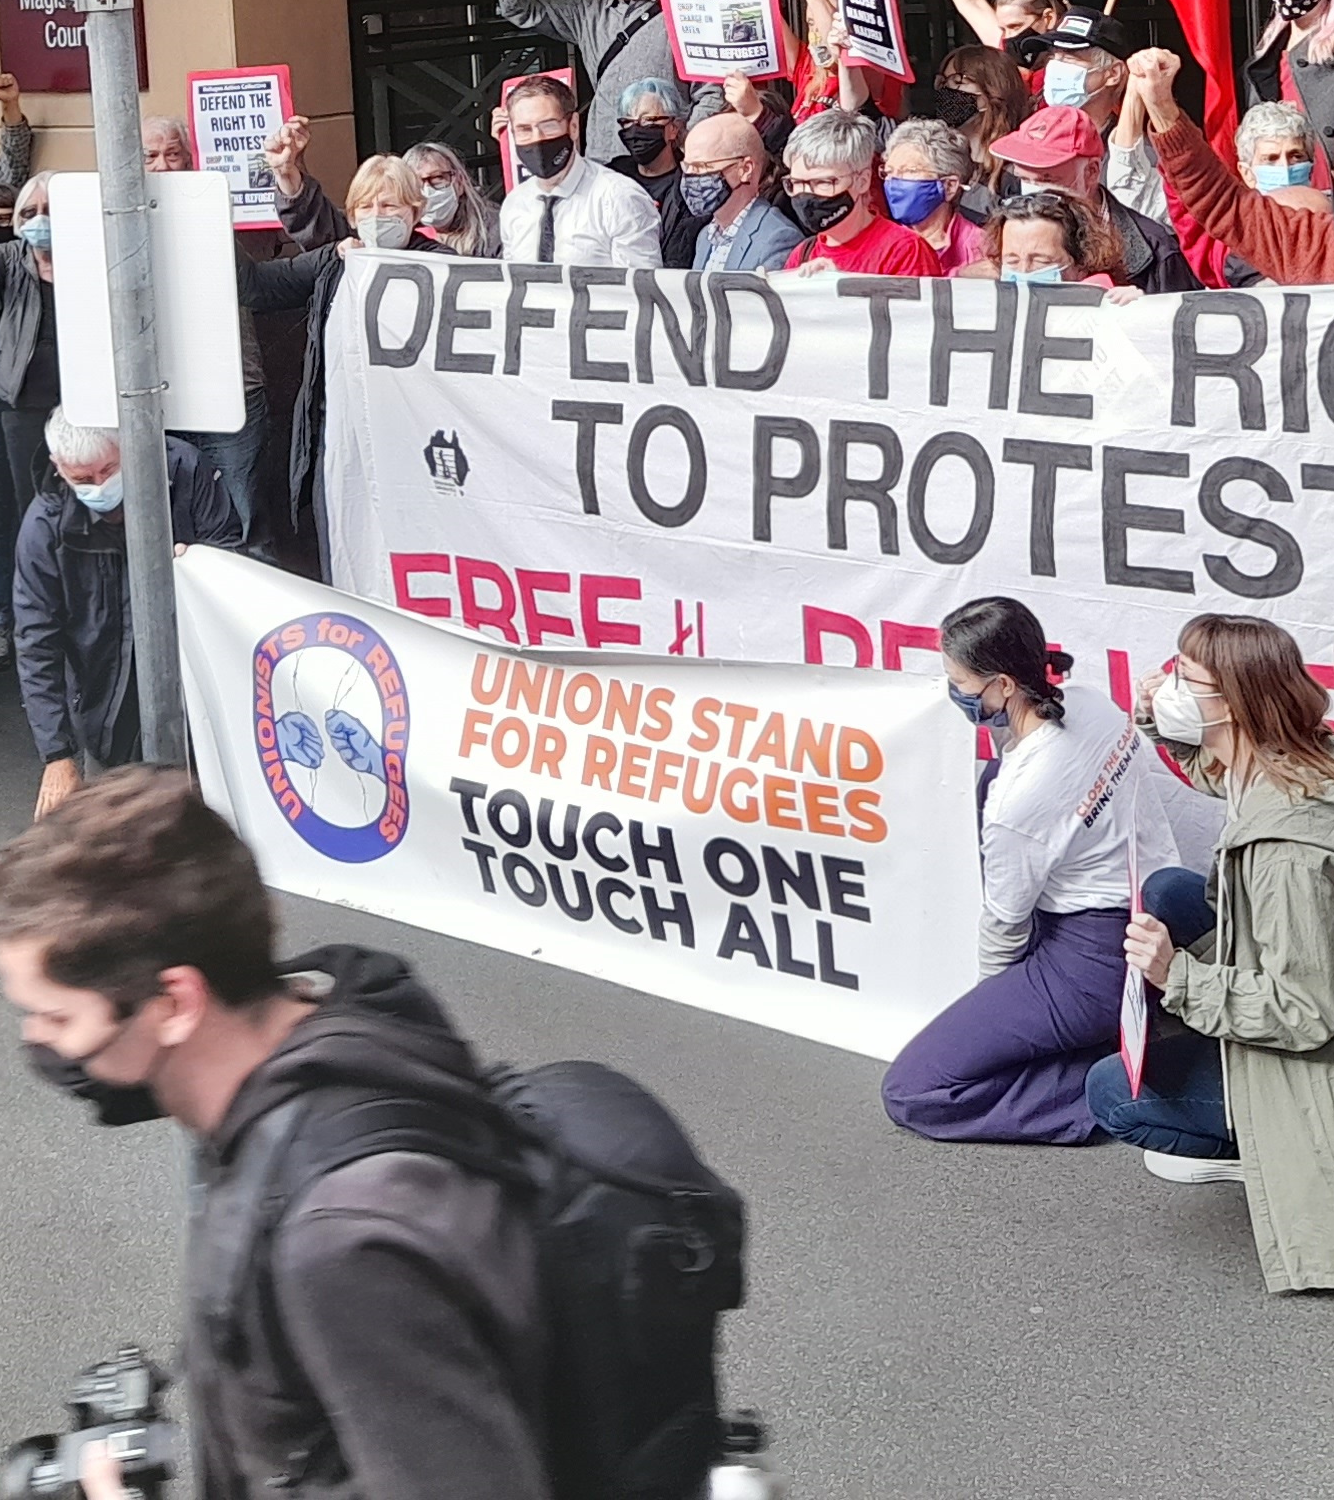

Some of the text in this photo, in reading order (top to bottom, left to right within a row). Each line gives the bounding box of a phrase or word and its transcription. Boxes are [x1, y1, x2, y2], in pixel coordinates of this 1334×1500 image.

[200, 94, 272, 111] DEFEND THE
[211, 115, 265, 131] RIGHT TO
[214, 136, 266, 151] PROTEST
[366, 263, 790, 391] DEFEND
[838, 277, 1108, 420] THE
[551, 400, 707, 529] TO
[256, 618, 406, 842] UNIONISTS for REFUGEES
[459, 707, 888, 843] FOR REFUGEES
[471, 653, 885, 783] UNIONS STAND
[1076, 773, 1107, 817] CLOSE
[1103, 750, 1120, 774] THE
[1083, 751, 1132, 828] BRING THEM
[450, 777, 871, 923] TOUCH ONE
[462, 837, 859, 991] TOUCH ALL
